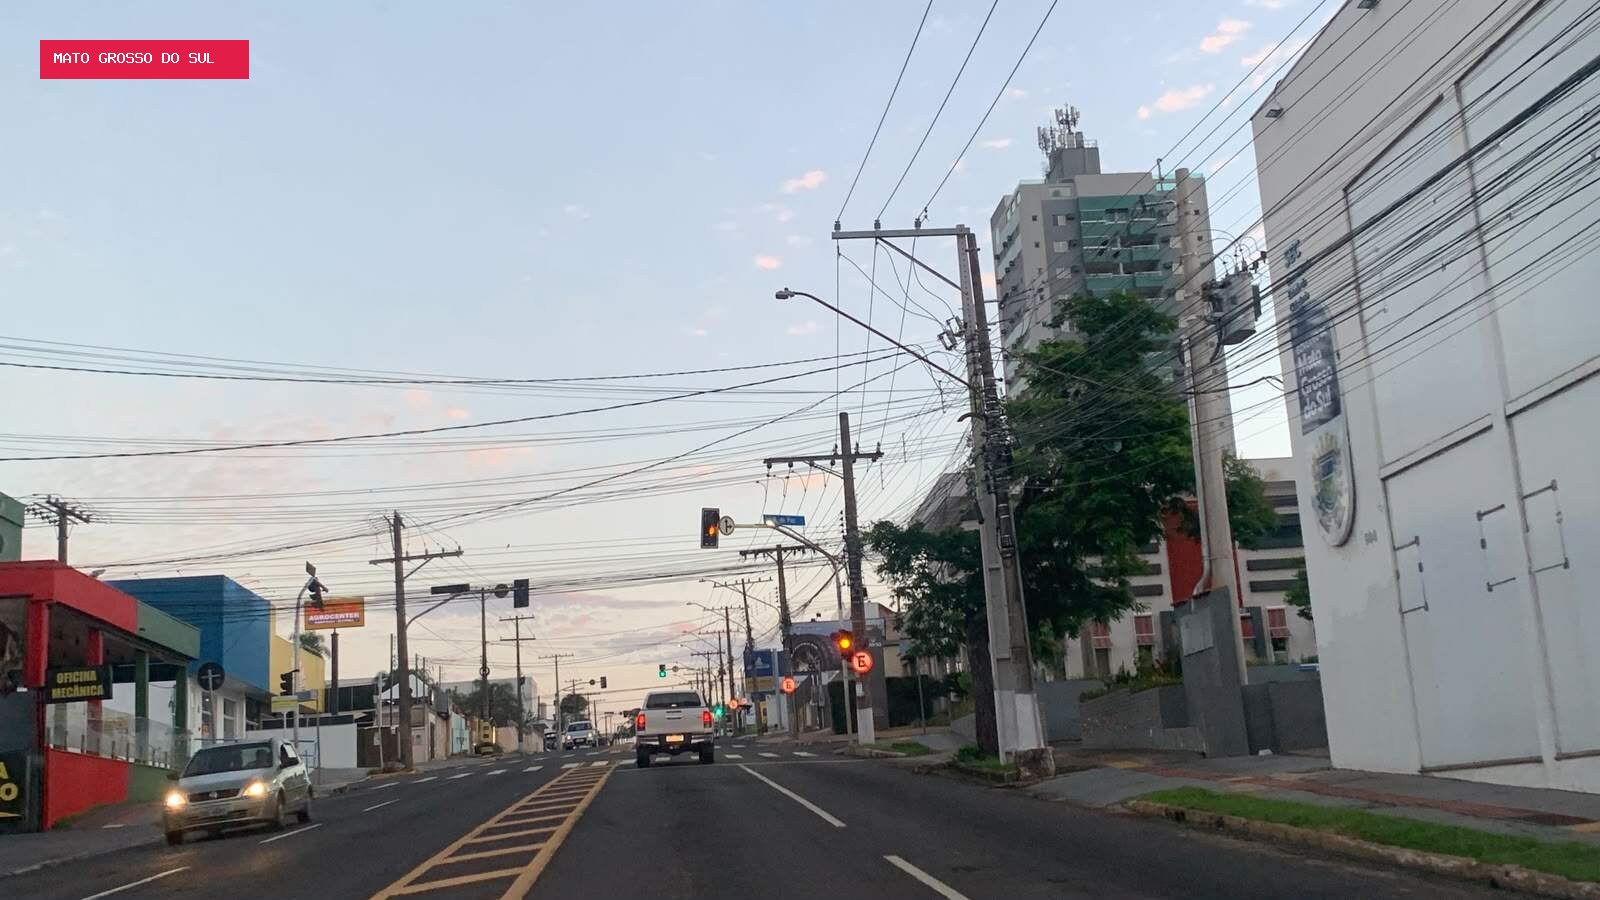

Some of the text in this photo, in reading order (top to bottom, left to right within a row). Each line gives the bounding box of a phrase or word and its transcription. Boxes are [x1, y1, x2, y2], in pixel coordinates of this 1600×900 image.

[308, 612, 360, 621] AGROCENTER
[56, 671, 97, 684] OFICINA
[51, 684, 104, 699] MECÂNICA
